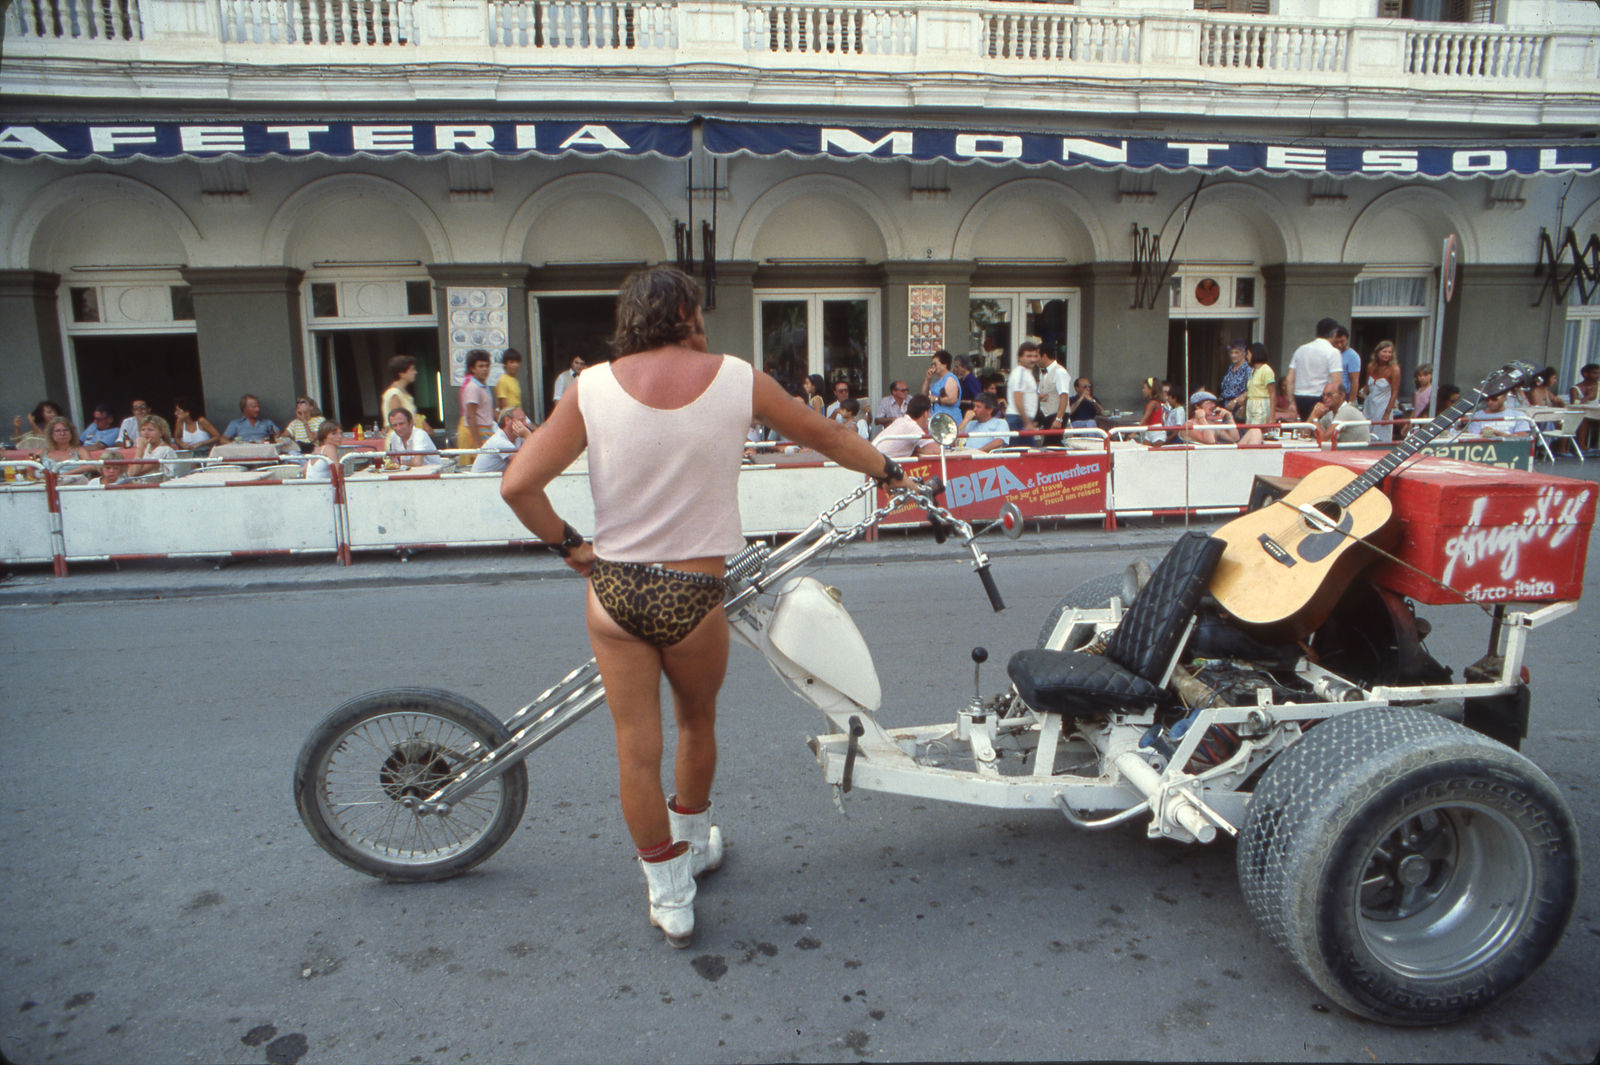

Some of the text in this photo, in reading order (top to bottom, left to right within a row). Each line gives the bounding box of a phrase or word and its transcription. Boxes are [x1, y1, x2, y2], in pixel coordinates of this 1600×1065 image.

[820, 128, 1594, 172] MONTESOL
[945, 465, 1028, 509] IBIZA
[1027, 478, 1036, 489] &
[1036, 463, 1100, 486] Formentera
[1005, 494, 1018, 502] The
[1032, 487, 1039, 495] of
[1041, 481, 1063, 492] travel
[1062, 486, 1070, 494] de
